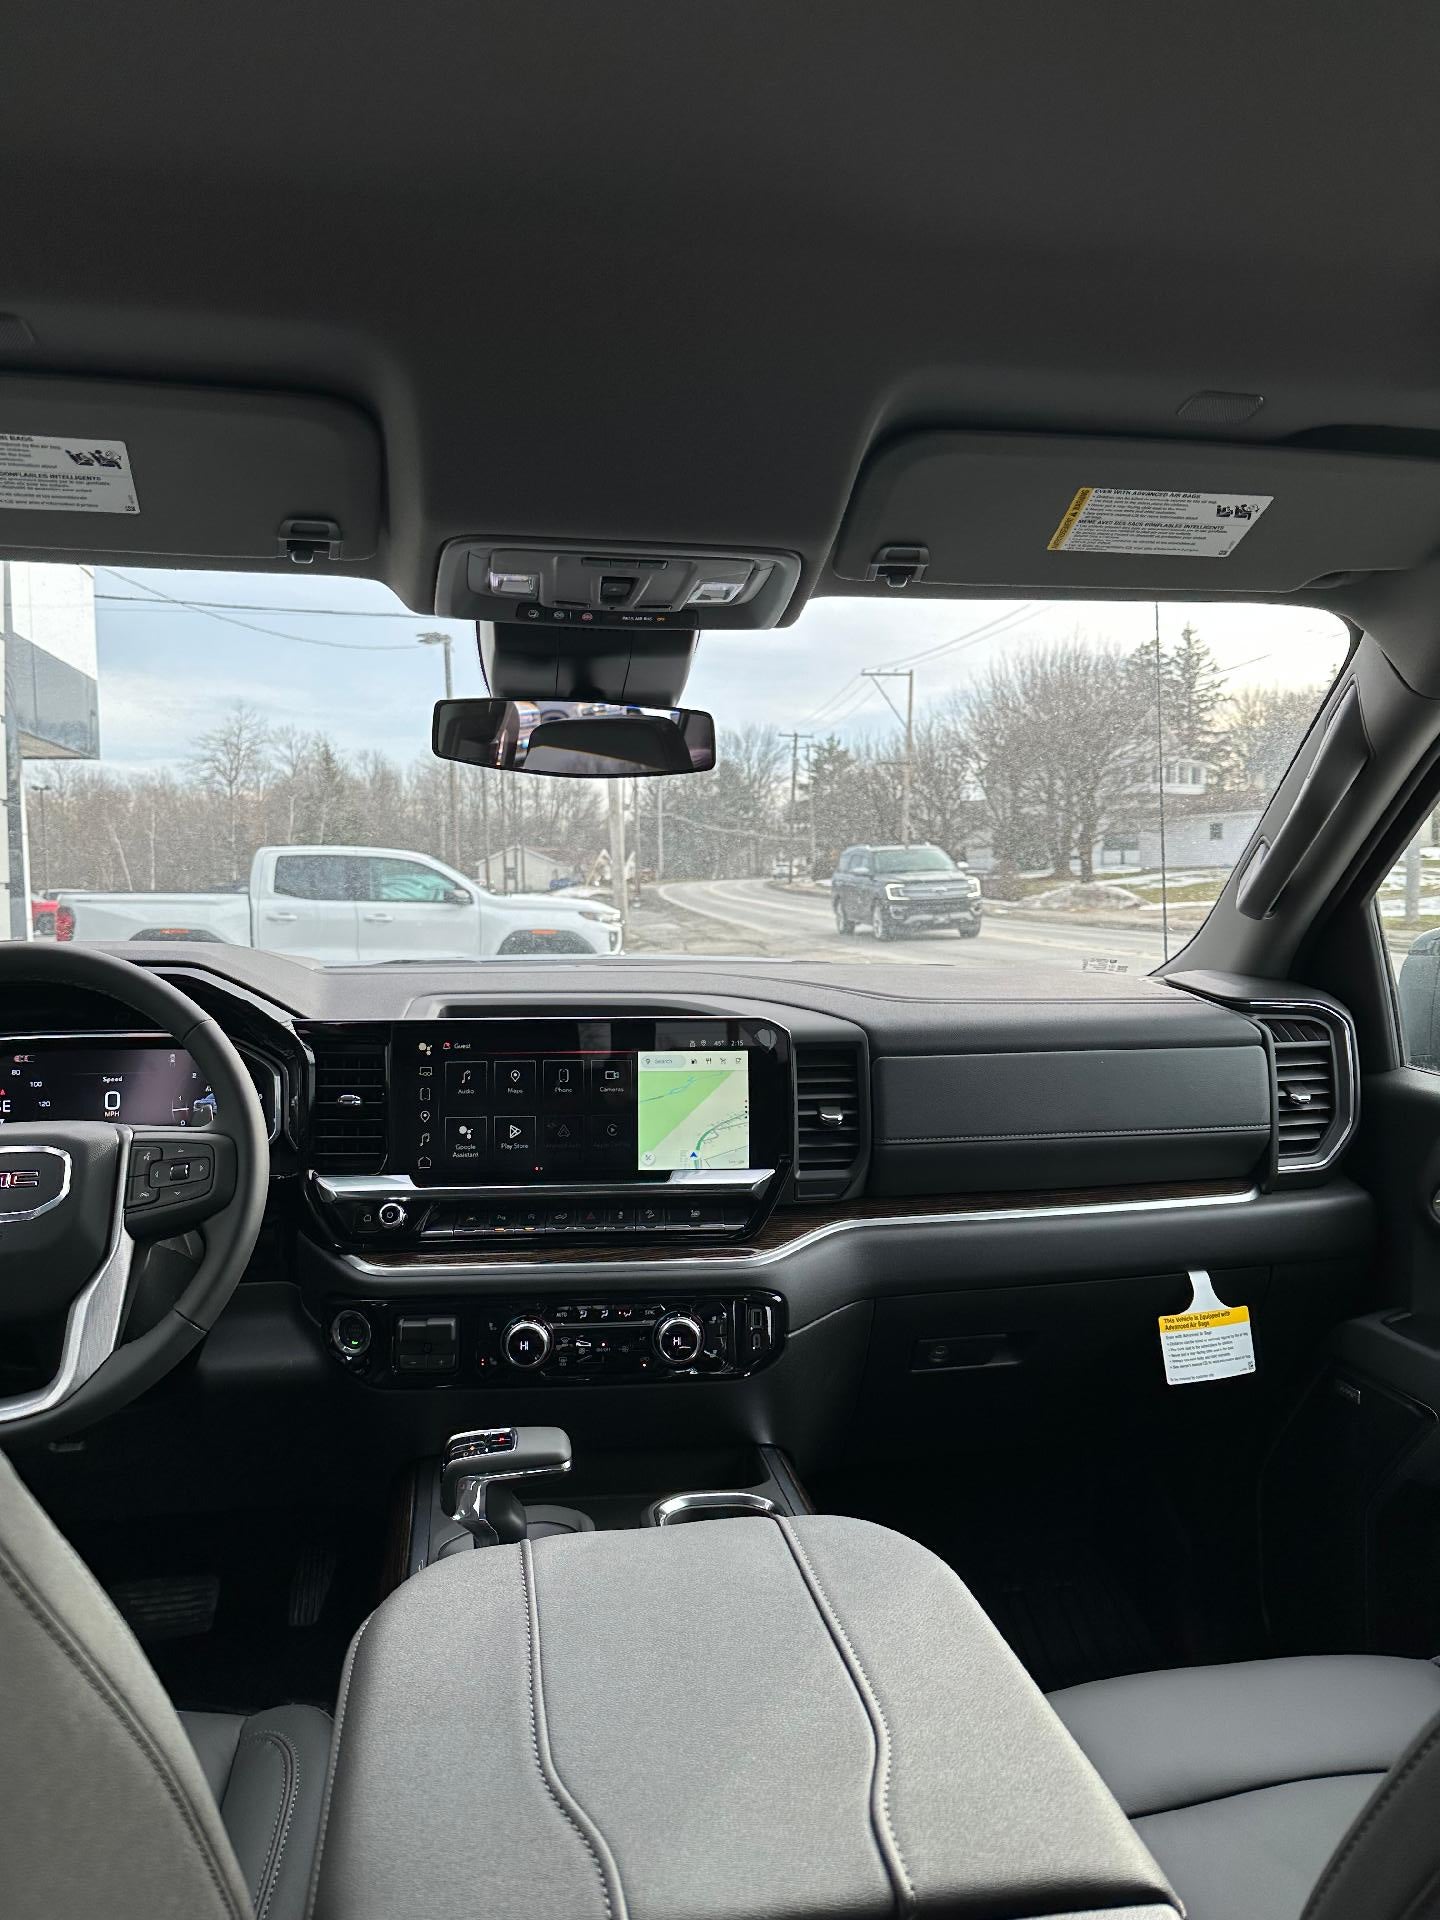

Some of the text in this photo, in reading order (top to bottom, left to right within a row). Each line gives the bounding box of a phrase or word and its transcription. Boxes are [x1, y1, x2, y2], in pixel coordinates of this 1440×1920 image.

[457, 1087, 475, 1095] Audio
[104, 1090, 121, 1111] 0
[455, 1143, 476, 1151] Google
[500, 1142, 512, 1151] Play
[452, 1151, 479, 1159] Assistant
[1176, 1315, 1194, 1323] Vehicle
[1199, 1312, 1220, 1321] Equipped
[1165, 1323, 1190, 1331] Advanced
[520, 1340, 530, 1351] HI
